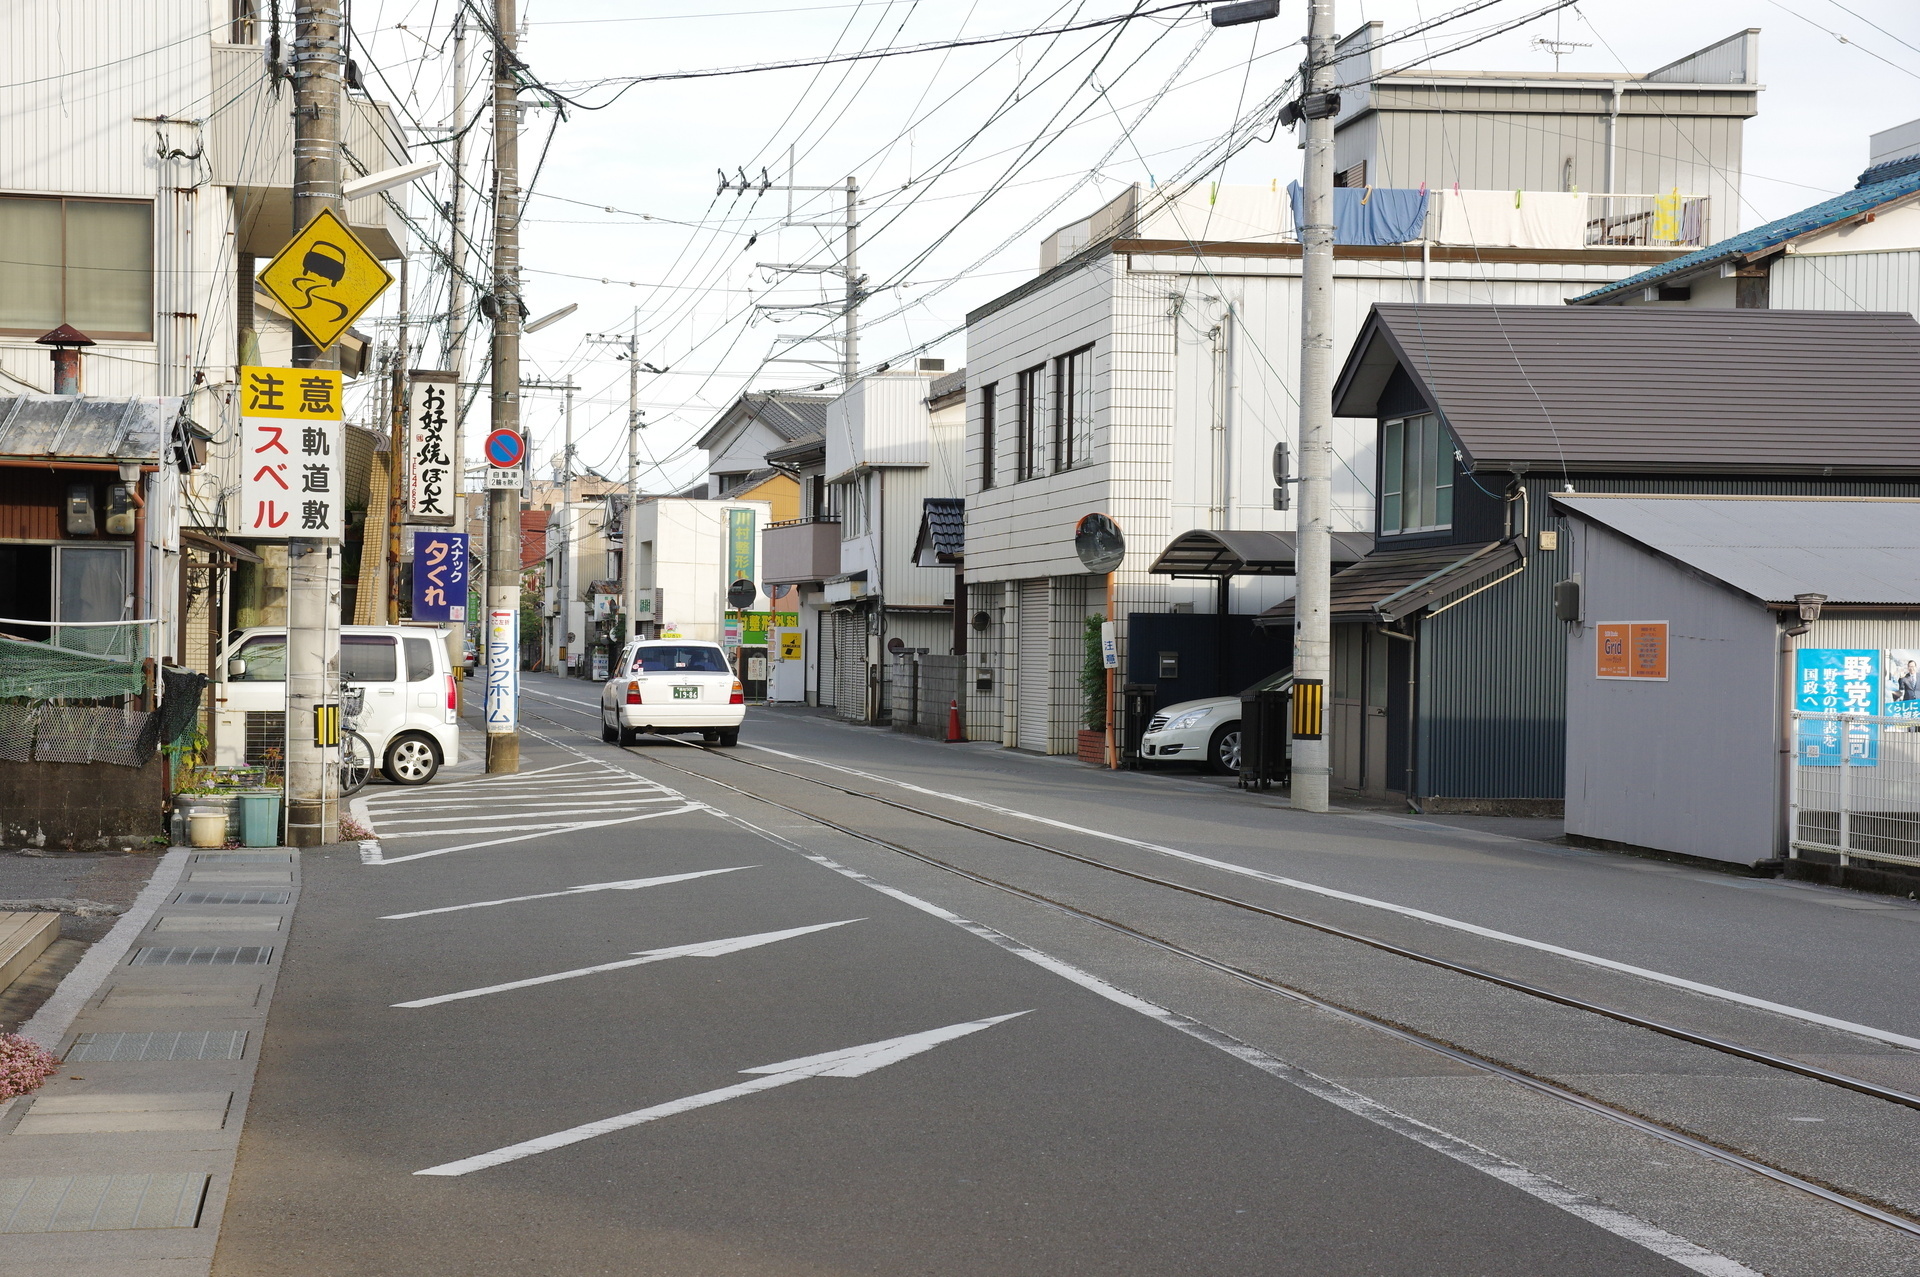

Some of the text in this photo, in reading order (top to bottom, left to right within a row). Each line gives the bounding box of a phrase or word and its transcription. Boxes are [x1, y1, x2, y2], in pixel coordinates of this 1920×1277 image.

[250, 373, 334, 413] 注意
[253, 426, 289, 529] スベル
[302, 426, 330, 530] 軌道敷
[493, 471, 518, 479] 自動車
[451, 537, 463, 583] スナック
[1104, 641, 1116, 664] 注意
[1605, 638, 1622, 655] Grid
[489, 642, 510, 723] ラックホーム
[679, 691, 698, 699] 19-86
[1803, 668, 1818, 706] 国政へ
[1887, 701, 1919, 713] くらしに
